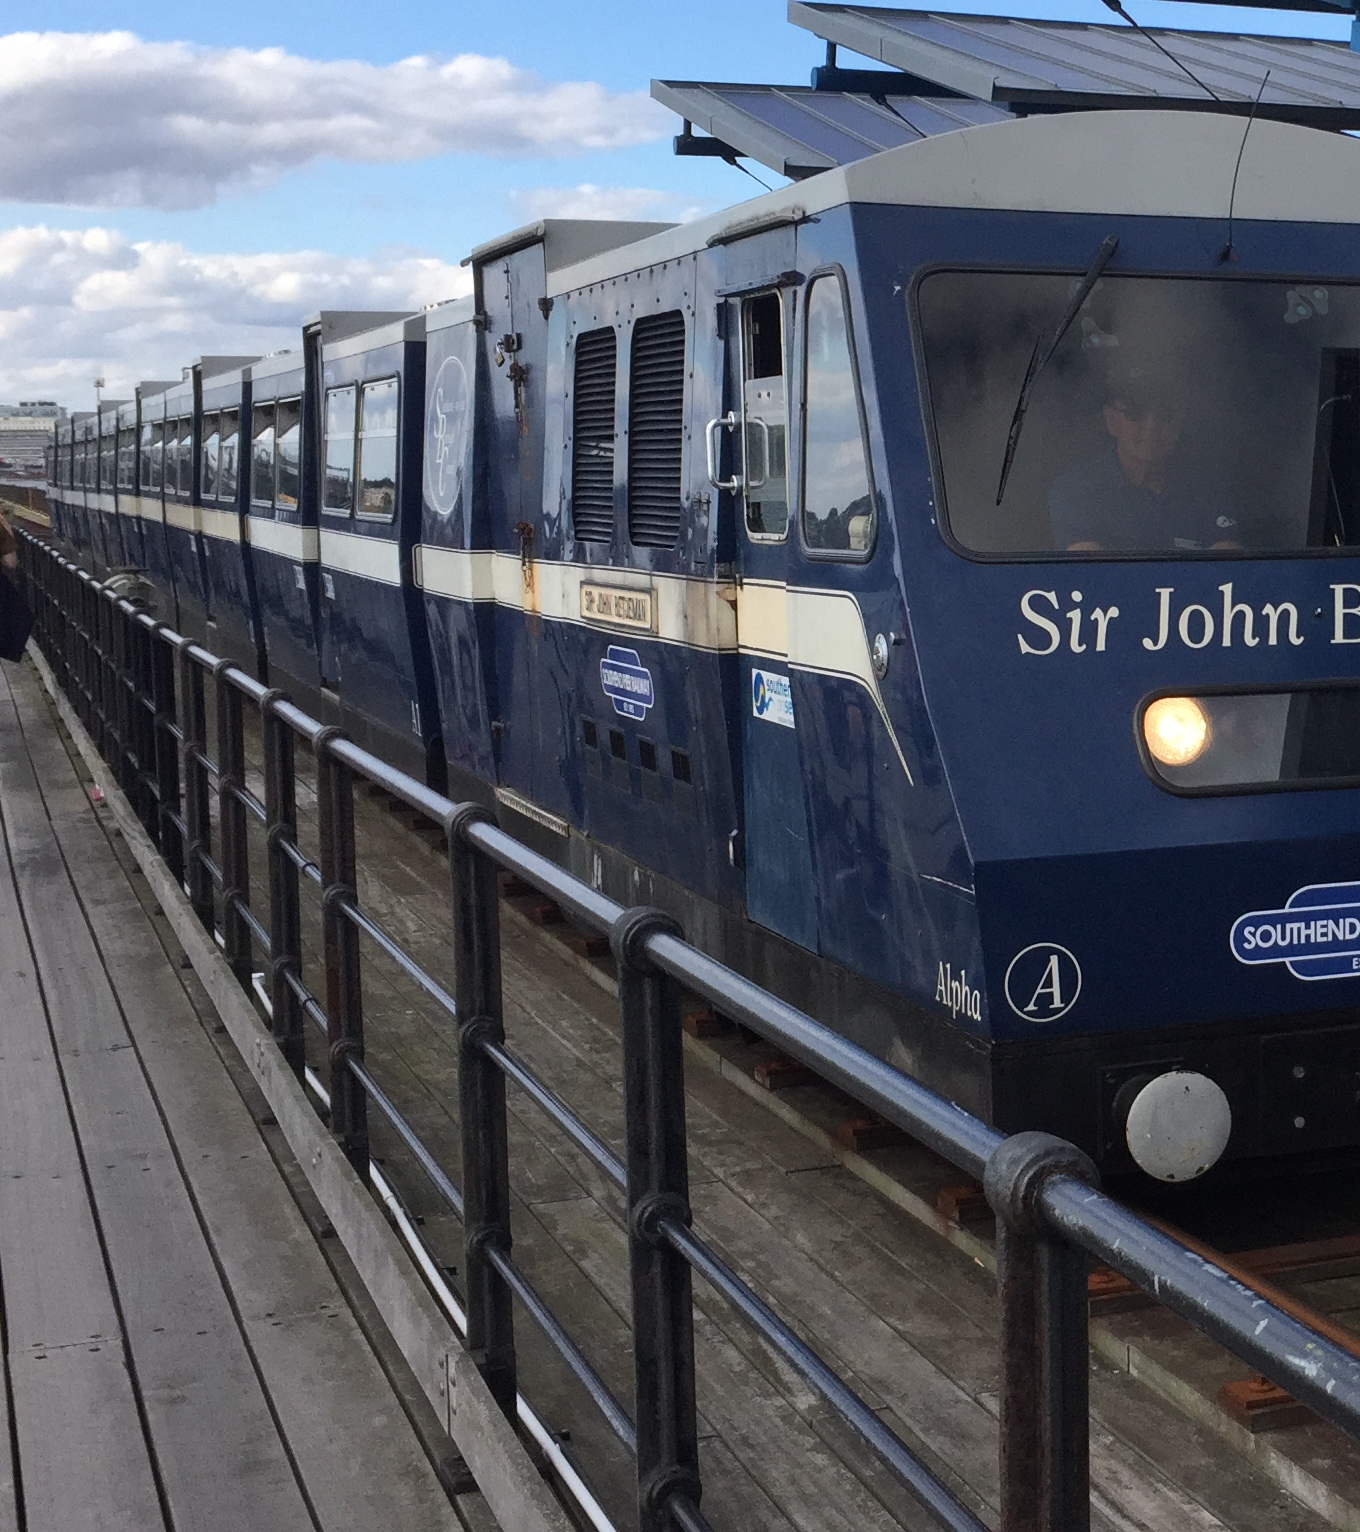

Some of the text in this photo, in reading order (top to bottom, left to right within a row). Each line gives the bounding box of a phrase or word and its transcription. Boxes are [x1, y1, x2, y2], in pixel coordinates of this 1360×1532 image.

[1017, 589, 1120, 656] Sir
[1142, 581, 1305, 652] John
[1242, 916, 1360, 950] SOUTHEND
[934, 960, 982, 1022] Alpha
[1023, 954, 1066, 1012] A
